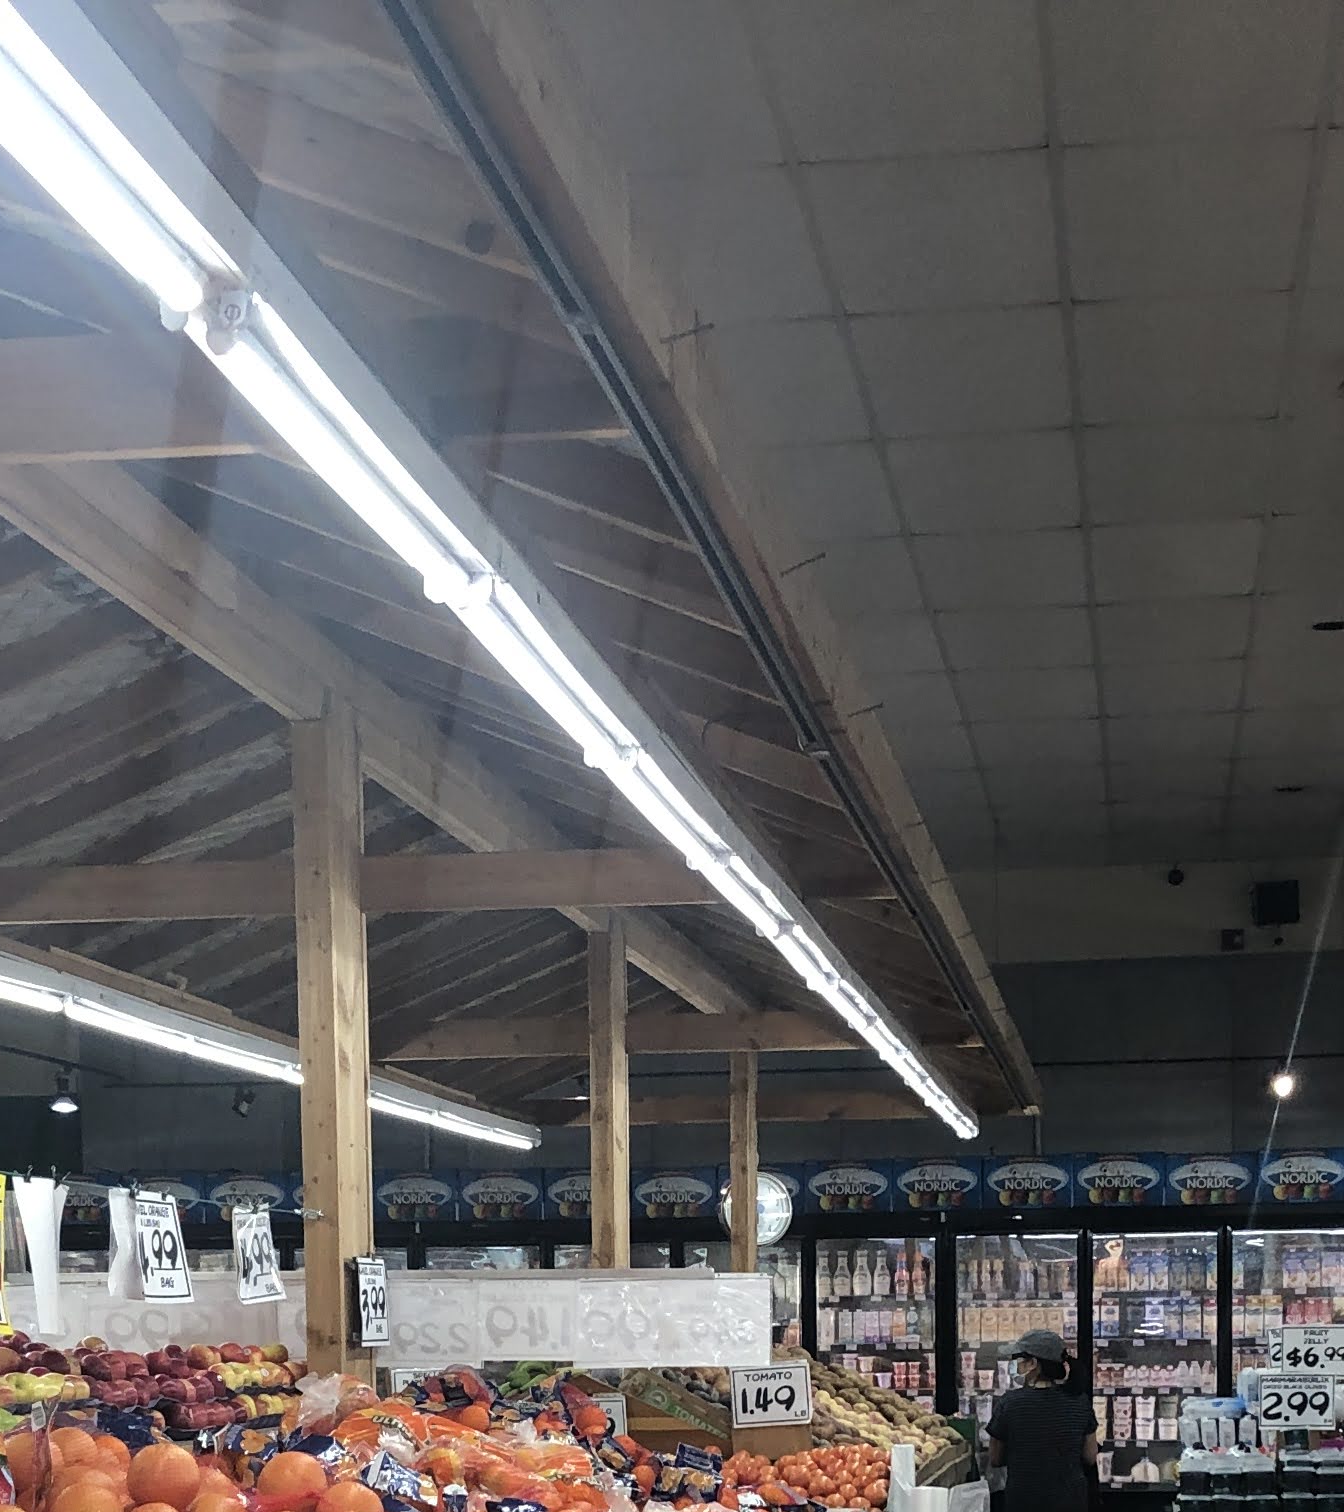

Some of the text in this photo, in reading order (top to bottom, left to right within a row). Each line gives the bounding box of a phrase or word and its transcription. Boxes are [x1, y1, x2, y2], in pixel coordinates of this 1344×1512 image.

[1005, 1178, 1052, 1190] NORDIC
[1095, 1176, 1143, 1188] NORDIC
[1186, 1177, 1234, 1189] NORDIC
[1280, 1172, 1328, 1184] NORDIC
[825, 1183, 871, 1195] NORDIC
[914, 1180, 961, 1192] NORDIC
[65, 1194, 99, 1206] ORDIC
[392, 1191, 435, 1204] NORDIC
[478, 1191, 522, 1204] NORDIC
[564, 1190, 591, 1202] NOR
[651, 1191, 696, 1203] NORDIC
[744, 1371, 792, 1382] TOMATO
[741, 1385, 795, 1415] 1.49
[1263, 1391, 1330, 1422] 2.99
